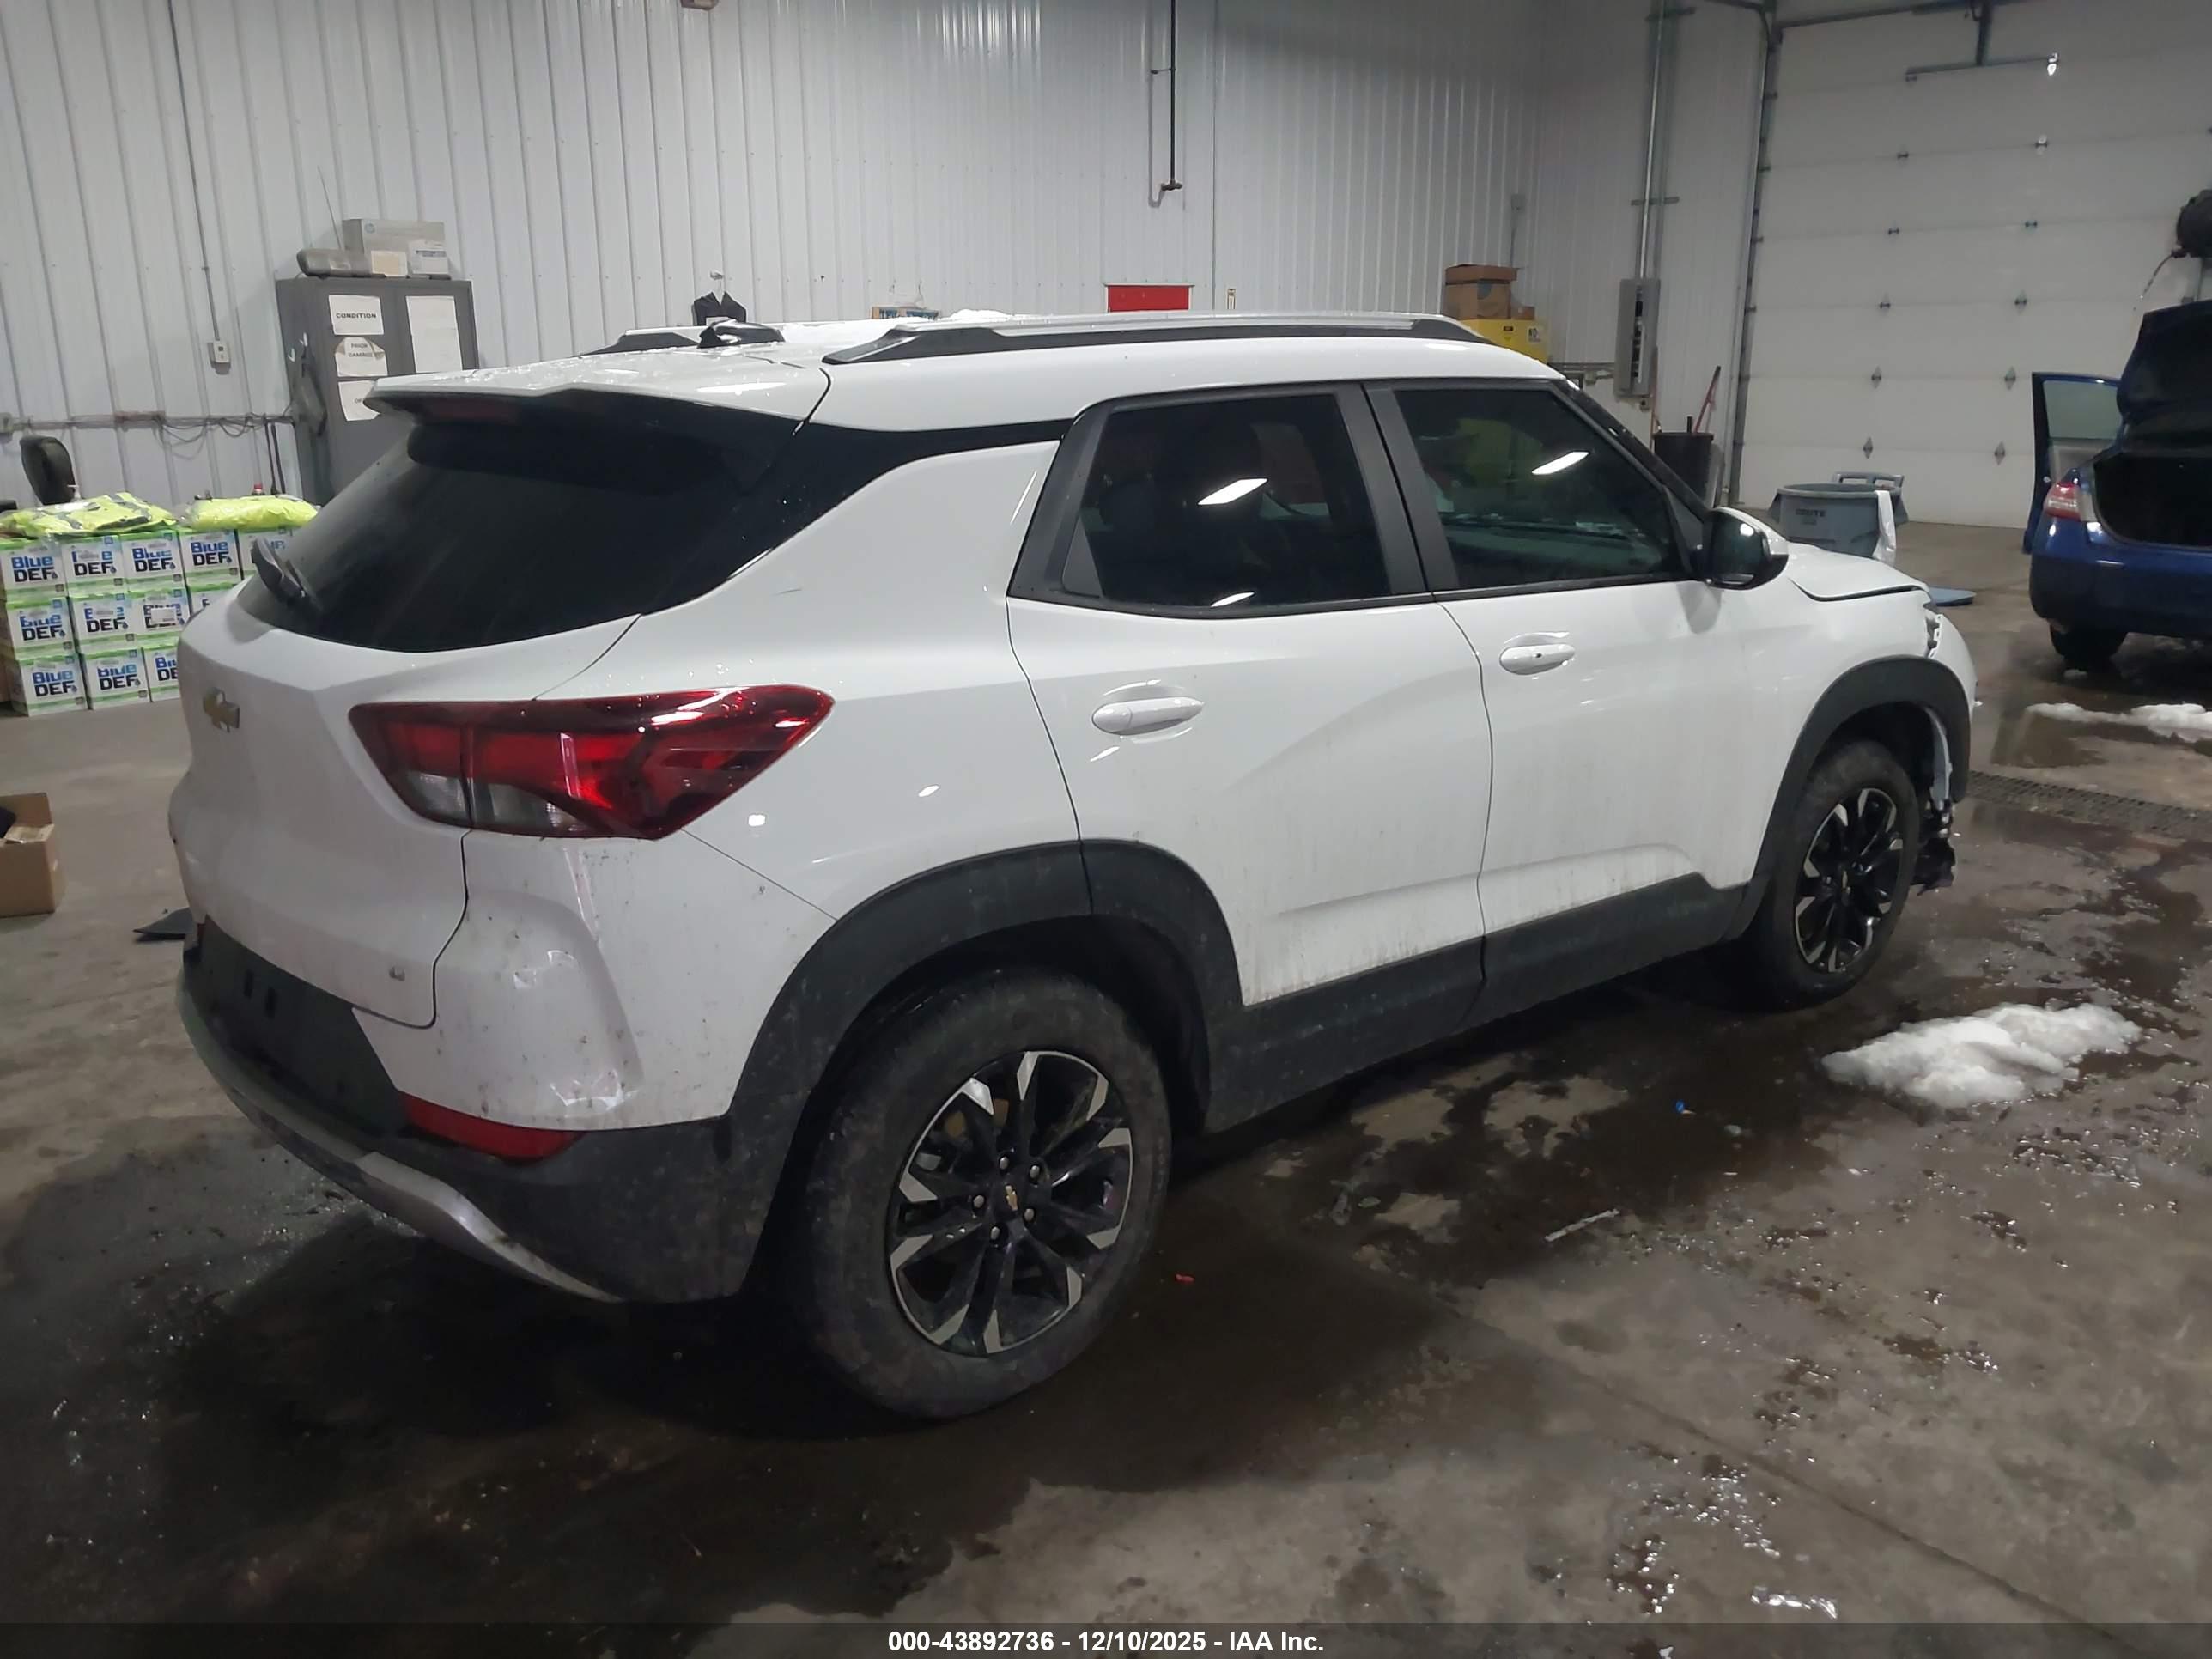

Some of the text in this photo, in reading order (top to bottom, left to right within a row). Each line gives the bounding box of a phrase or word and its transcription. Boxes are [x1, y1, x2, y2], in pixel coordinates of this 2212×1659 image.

[132, 547, 172, 559] Blue
[191, 541, 228, 553] Blue
[11, 556, 53, 568] Blue
[134, 557, 173, 572] DEF
[192, 551, 229, 566] DEF
[14, 567, 54, 582] DEF
[73, 561, 113, 576] DEF
[21, 624, 63, 641] DEF
[86, 617, 125, 633] DEF
[32, 670, 74, 684] Blue
[97, 664, 137, 678] Blue
[156, 667, 179, 682] DE
[34, 680, 75, 697] DEF
[99, 674, 138, 690] DEF
